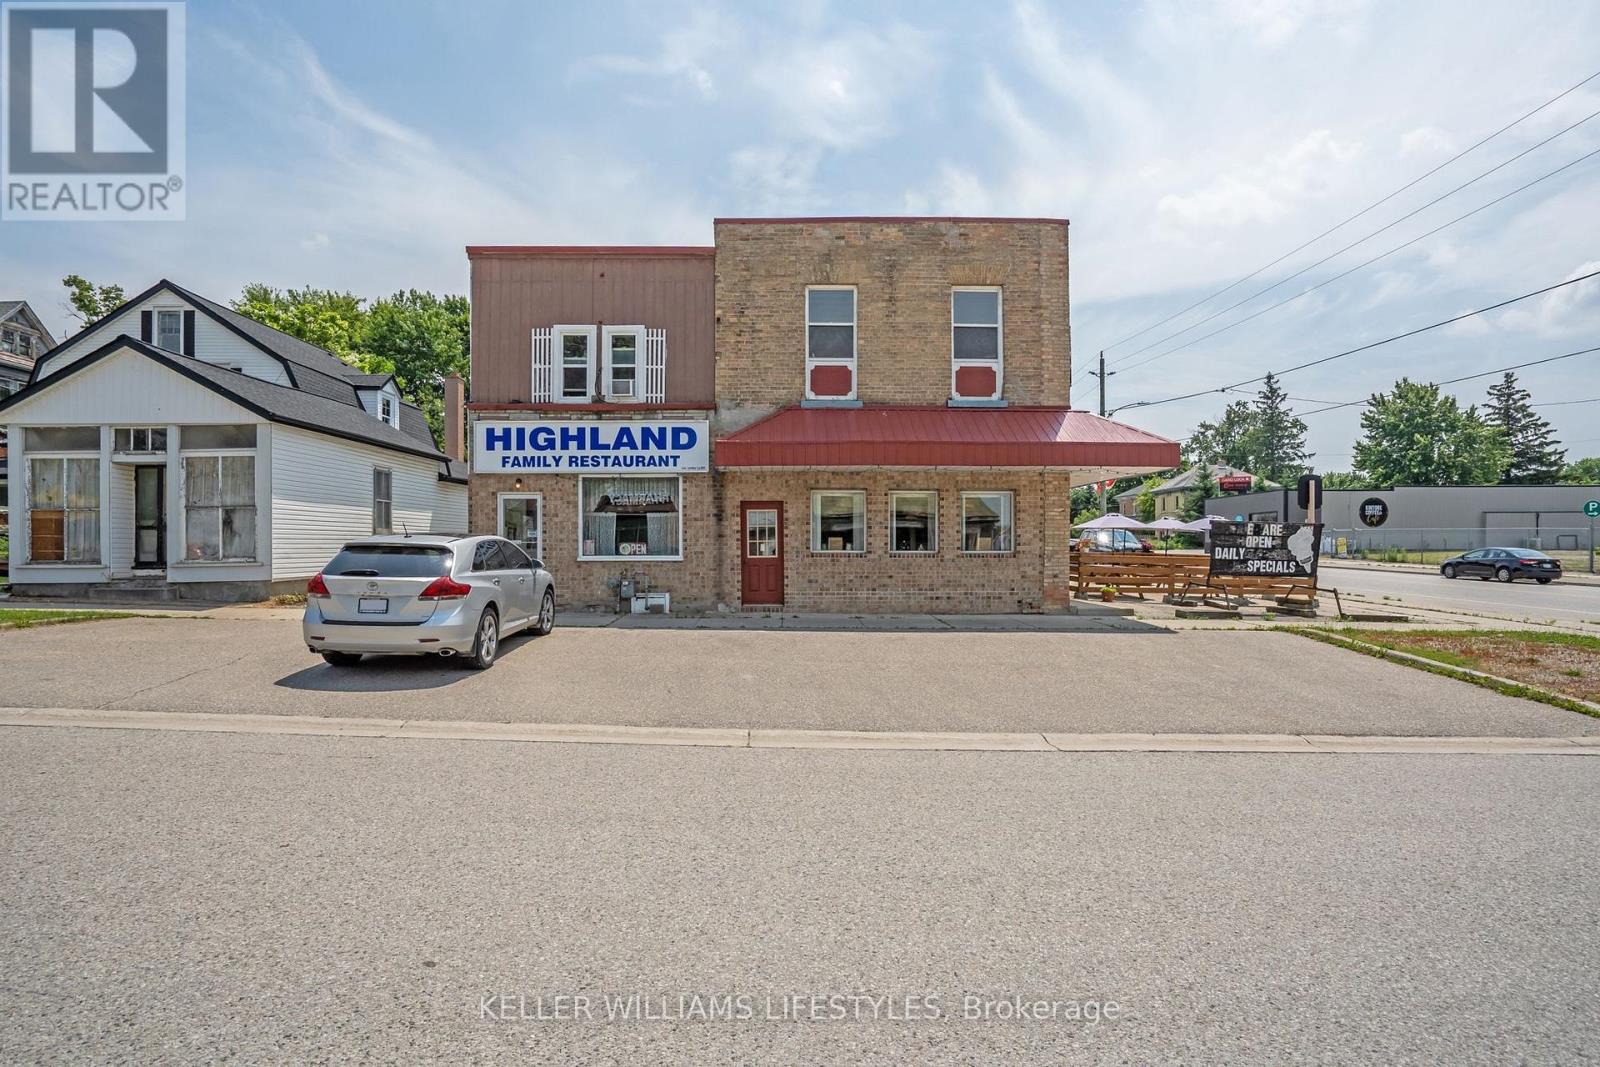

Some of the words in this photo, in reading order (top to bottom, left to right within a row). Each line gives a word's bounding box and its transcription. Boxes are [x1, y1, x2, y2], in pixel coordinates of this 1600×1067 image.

[485, 426, 698, 451] HIGHLAND
[501, 455, 563, 468] FAMILY
[568, 455, 680, 467] RESTAURANT
[1589, 502, 1598, 511] P
[1262, 524, 1283, 536] ARE
[1245, 536, 1273, 548] OPEN
[619, 543, 647, 555] OPEN
[1214, 547, 1246, 560] DAILY
[1246, 560, 1297, 573] SPECIALS
